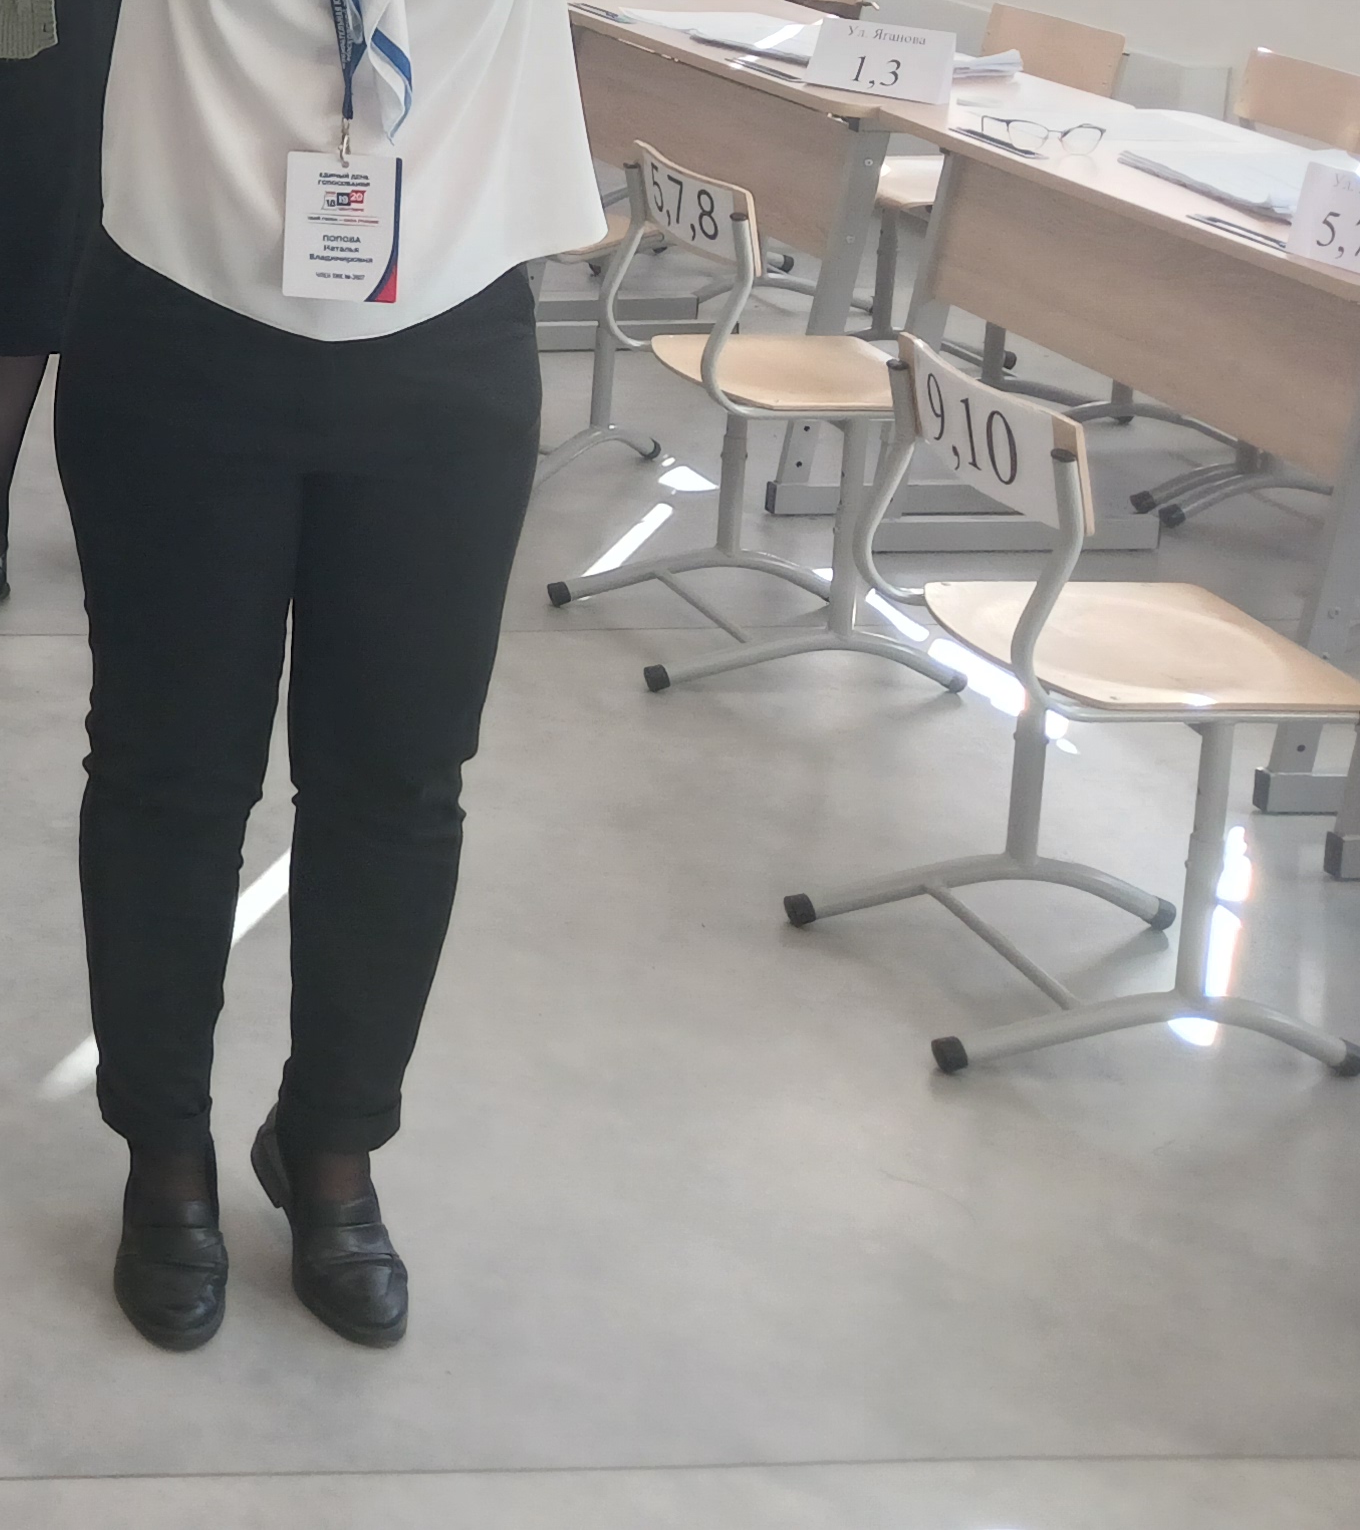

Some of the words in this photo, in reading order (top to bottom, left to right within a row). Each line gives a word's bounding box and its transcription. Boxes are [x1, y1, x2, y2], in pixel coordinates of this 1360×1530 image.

[852, 55, 901, 89] 1,3
[350, 192, 363, 201] 20
[651, 161, 718, 241] 5,7,8
[323, 235, 361, 244] ПОПОВА
[926, 372, 1018, 486] 9,10
